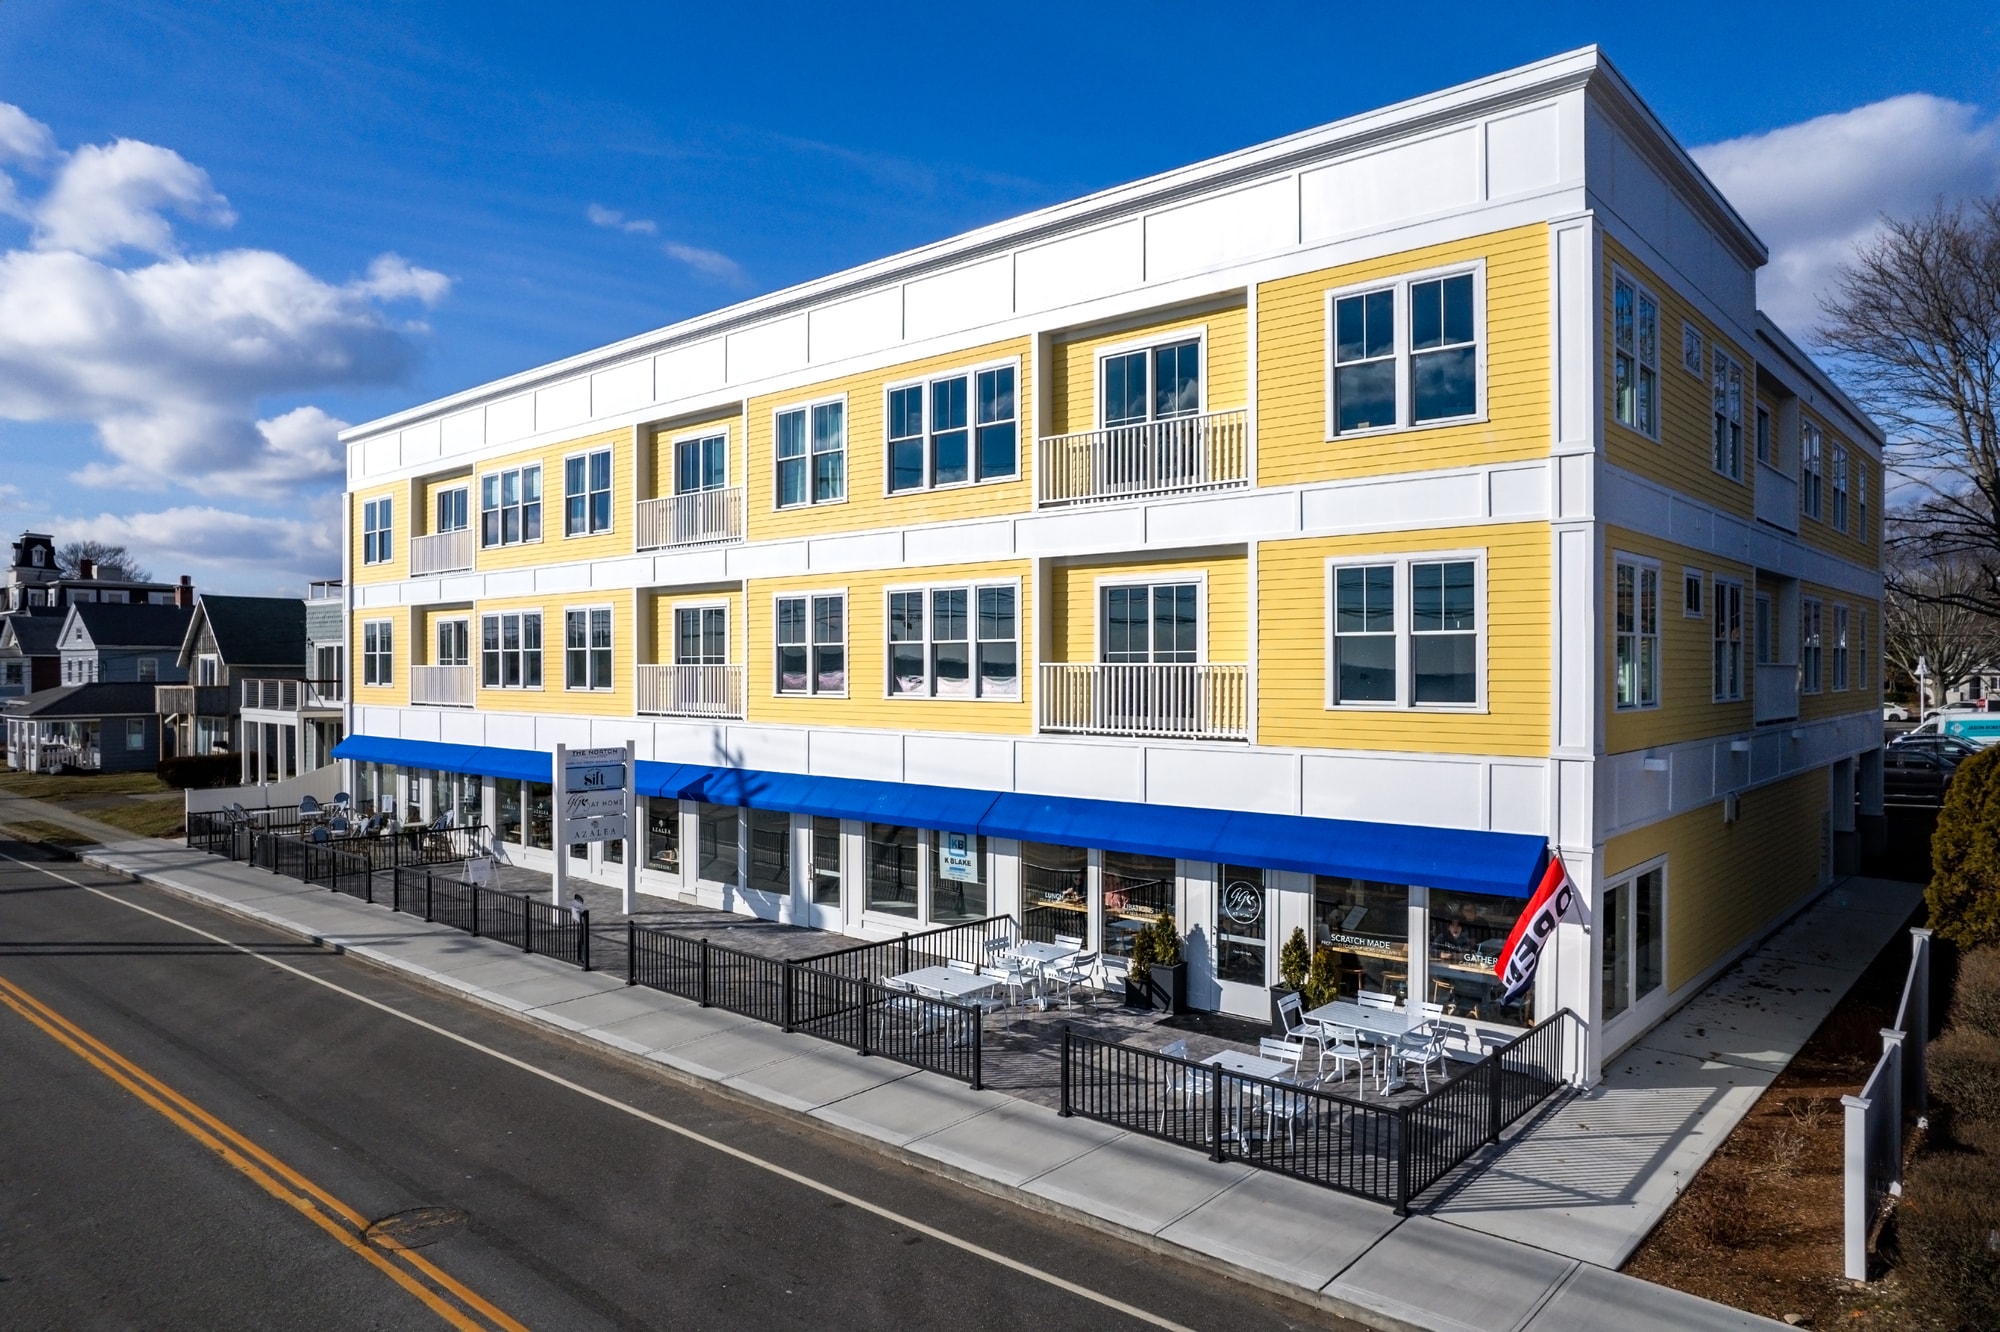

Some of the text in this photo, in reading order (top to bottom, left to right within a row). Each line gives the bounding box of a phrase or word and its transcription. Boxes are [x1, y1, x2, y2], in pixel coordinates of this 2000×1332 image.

[584, 771, 604, 786] Sift
[602, 799, 623, 807] HOME
[574, 827, 616, 839] AZALEA
[652, 826, 671, 835] AZALEA
[951, 839, 965, 850] KB
[950, 858, 972, 867] BLAKE
[1330, 933, 1391, 950] SCRATCH MADE
[1463, 953, 1499, 965] GATHER
